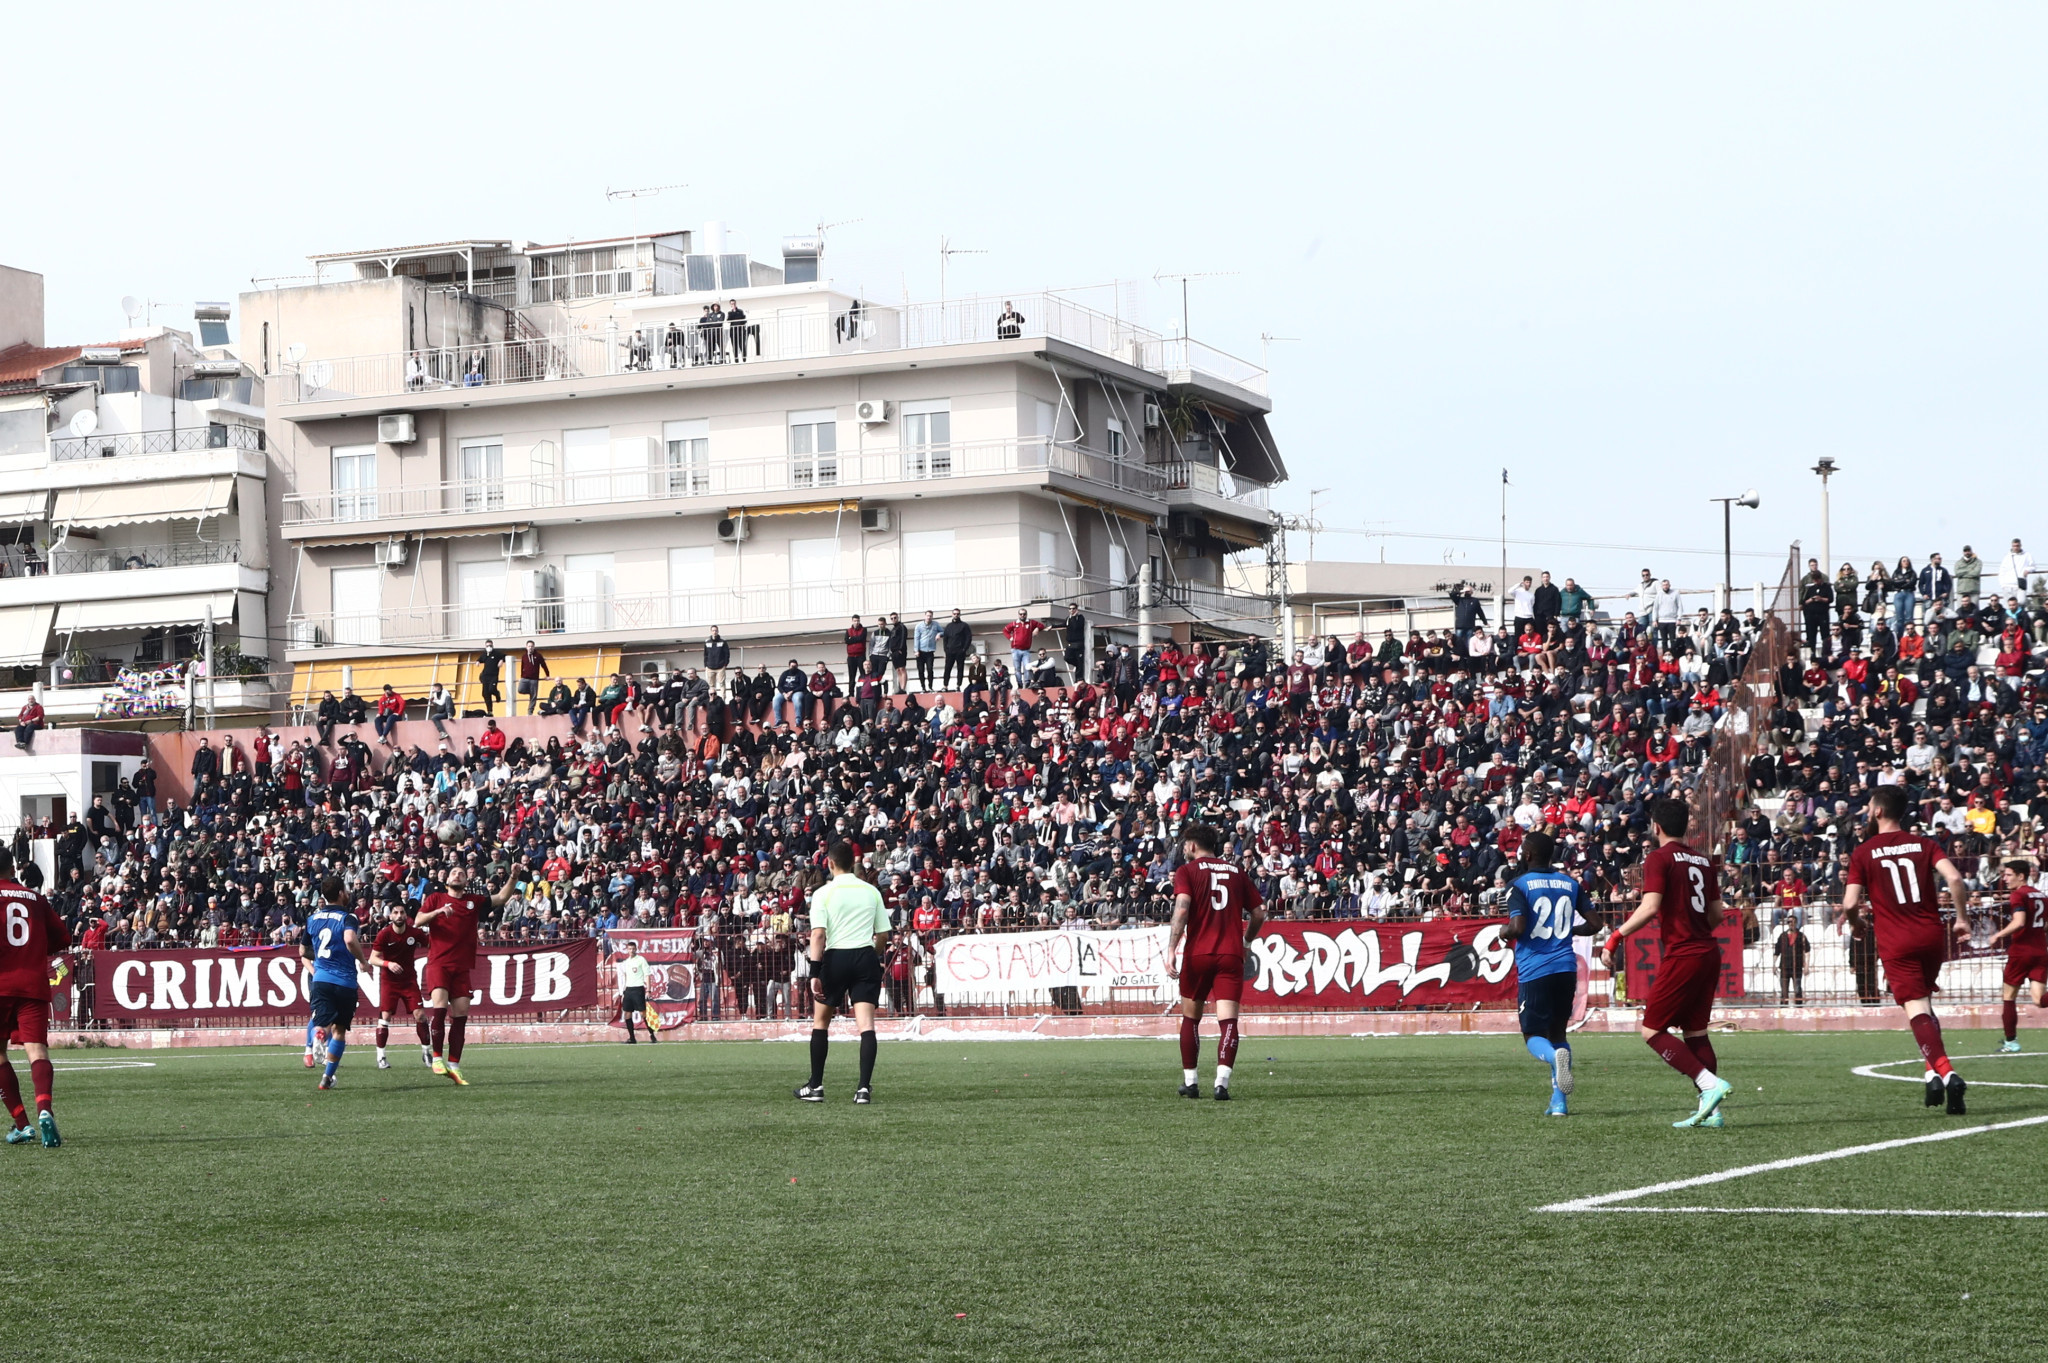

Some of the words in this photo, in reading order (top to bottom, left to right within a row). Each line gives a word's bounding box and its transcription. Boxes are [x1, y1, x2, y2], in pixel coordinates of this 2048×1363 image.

[1211, 872, 1230, 911] 5
[1688, 866, 1706, 913] 3
[1880, 858, 1921, 905] 11
[6, 902, 30, 947] 6
[1530, 895, 1573, 940] 20
[2032, 900, 2045, 928] 2
[317, 928, 332, 959] 2
[946, 934, 1073, 981] ESTADIO
[413, 952, 572, 1009] CUB
[1112, 975, 1128, 986] NO
[1131, 974, 1159, 985] GATE
